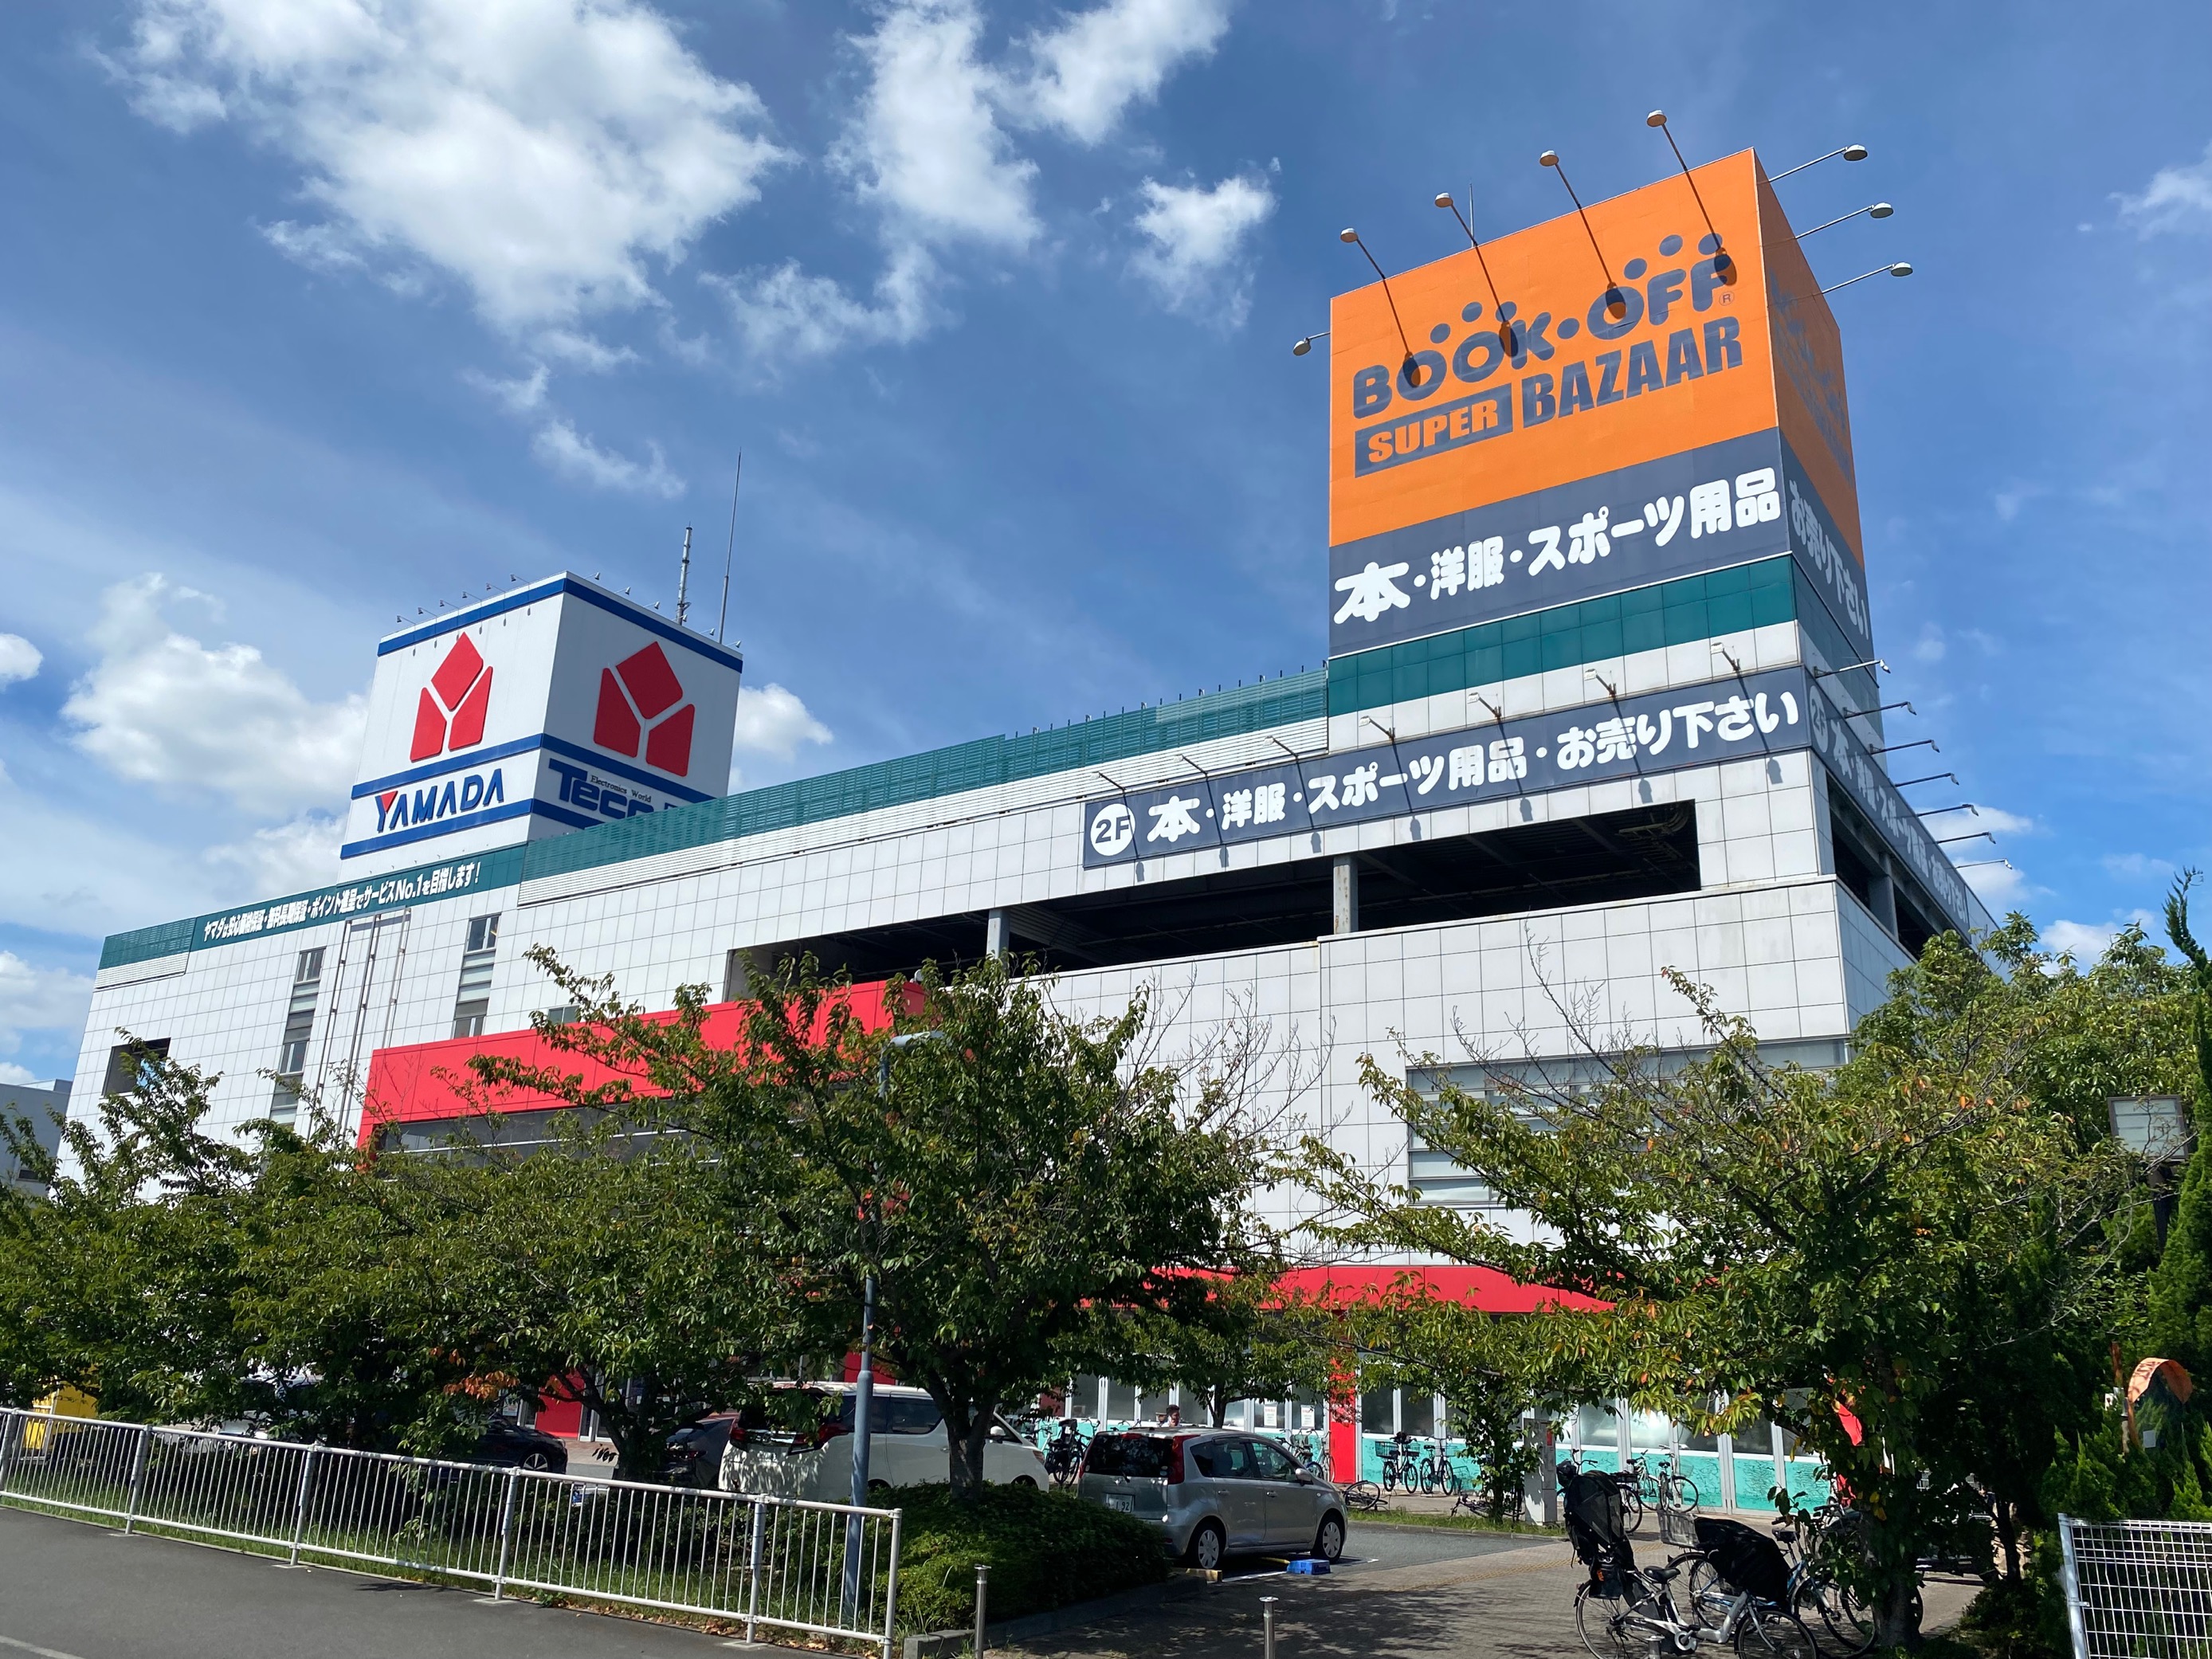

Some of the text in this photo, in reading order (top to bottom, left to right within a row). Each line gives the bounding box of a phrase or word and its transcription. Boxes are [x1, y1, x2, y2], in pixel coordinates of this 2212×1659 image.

[1368, 316, 1743, 464] SUPER BAZAAR
[1790, 480, 1869, 641] お売り下さい
[375, 768, 504, 833] YAMADA
[590, 775, 652, 803] Electronics World
[1096, 818, 1129, 845] 2F
